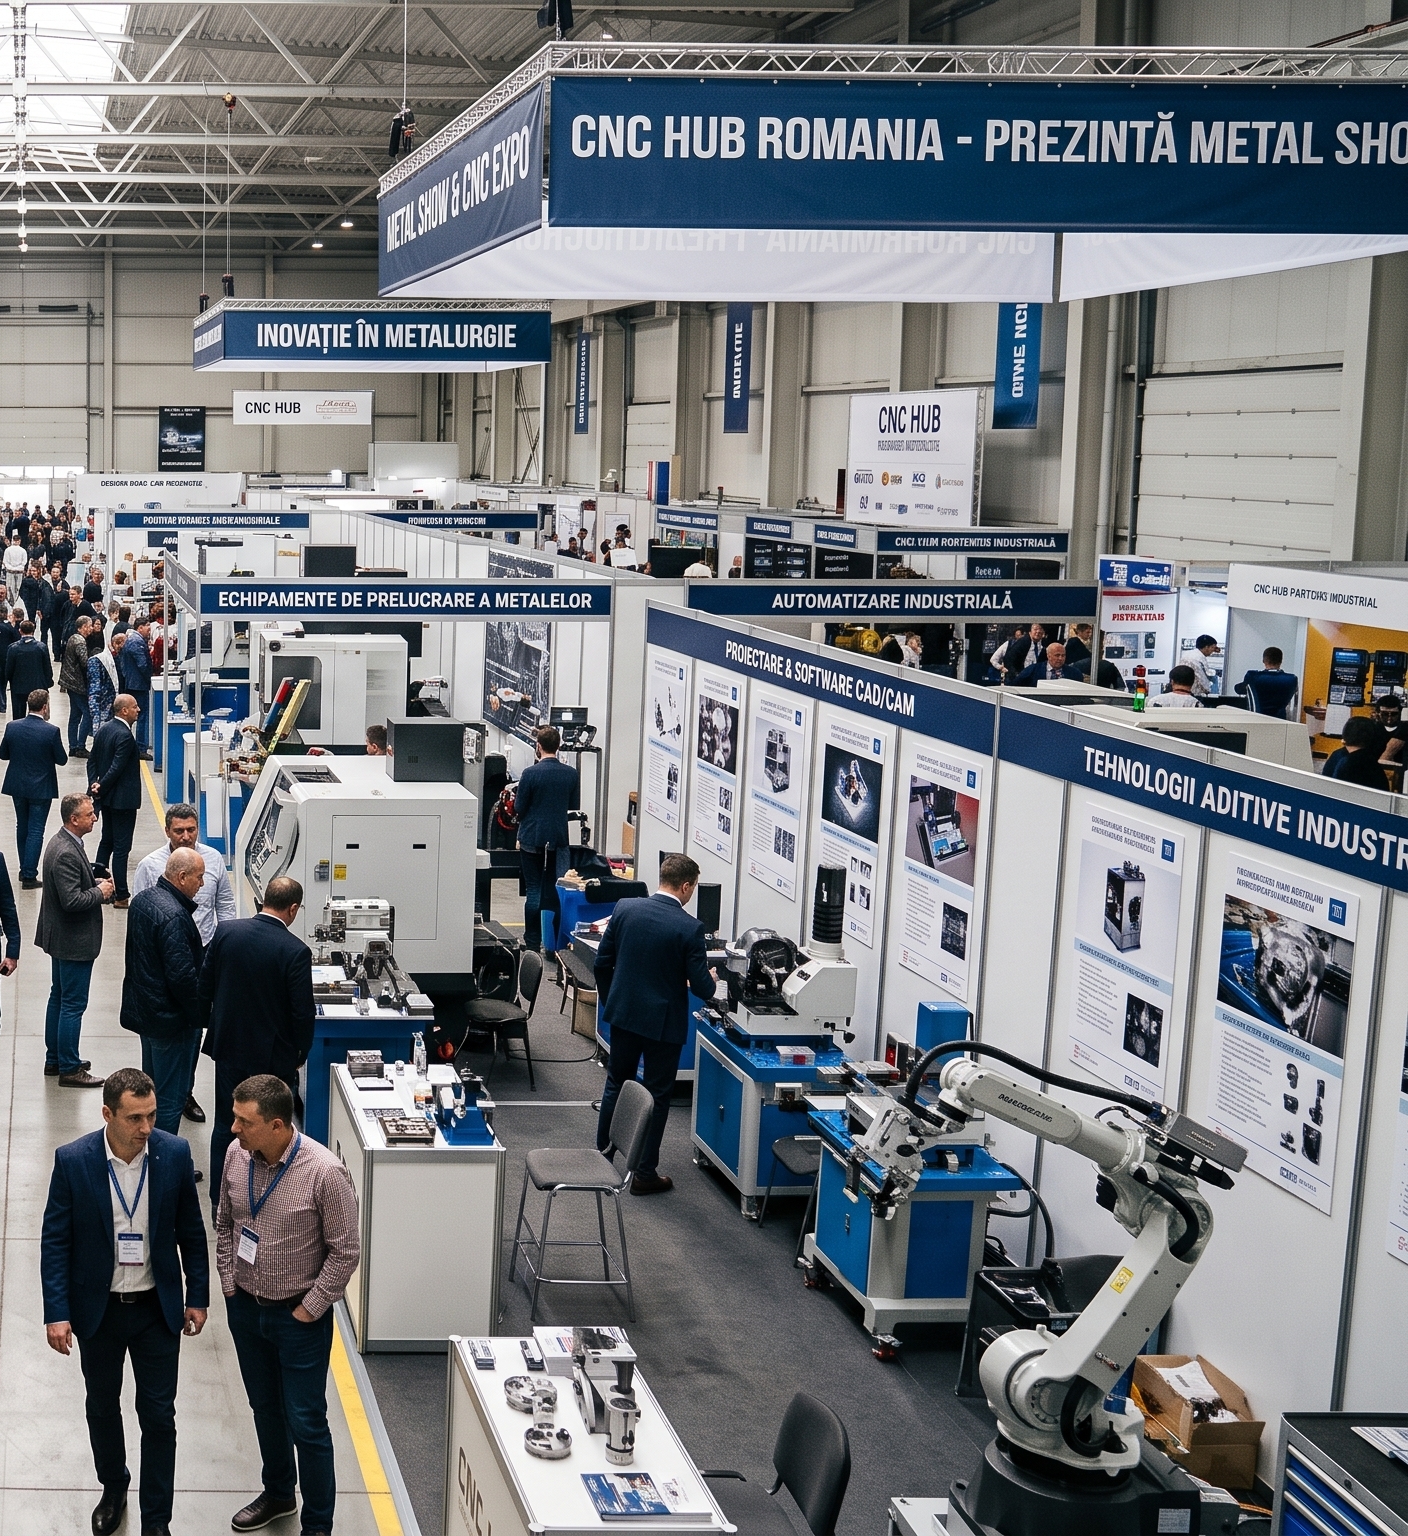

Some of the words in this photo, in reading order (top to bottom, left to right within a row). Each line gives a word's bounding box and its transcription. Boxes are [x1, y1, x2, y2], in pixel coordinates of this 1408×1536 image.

[571, 114, 652, 159] CNC
[664, 116, 746, 160] HUB
[758, 117, 944, 162] ROMANIA
[955, 136, 973, 145] -
[985, 111, 1178, 164] PREZINTĂ
[1189, 121, 1324, 165] METAL
[386, 200, 416, 253] METAL
[417, 177, 449, 236] SHOW
[451, 171, 460, 218] &
[462, 152, 490, 212] CNC
[492, 124, 530, 195] EXPO
[257, 323, 352, 354] INOVAȚIE
[356, 318, 380, 348] ÎN
[385, 323, 517, 348] METALURGIE
[245, 402, 271, 414] CNC
[275, 402, 301, 414] HUB
[878, 405, 907, 434] CNC
[911, 404, 941, 434] HUB
[219, 591, 338, 608] ECHIPAMENTE
[342, 592, 364, 608] DE
[367, 592, 476, 608] PRELUCRARE
[478, 593, 492, 609] A
[495, 593, 593, 610] METALELOR
[771, 593, 900, 609] AUTOMATIZARE
[1253, 583, 1271, 595] CNC
[1272, 585, 1289, 597] HUB
[725, 639, 784, 676] PROIECTARE
[785, 660, 792, 679] &
[794, 662, 853, 699] SOFTWARE
[855, 678, 915, 718] CAD/CAM
[1084, 745, 1196, 806] TEHNOLOGII
[1200, 782, 1292, 836] ADITIVE
